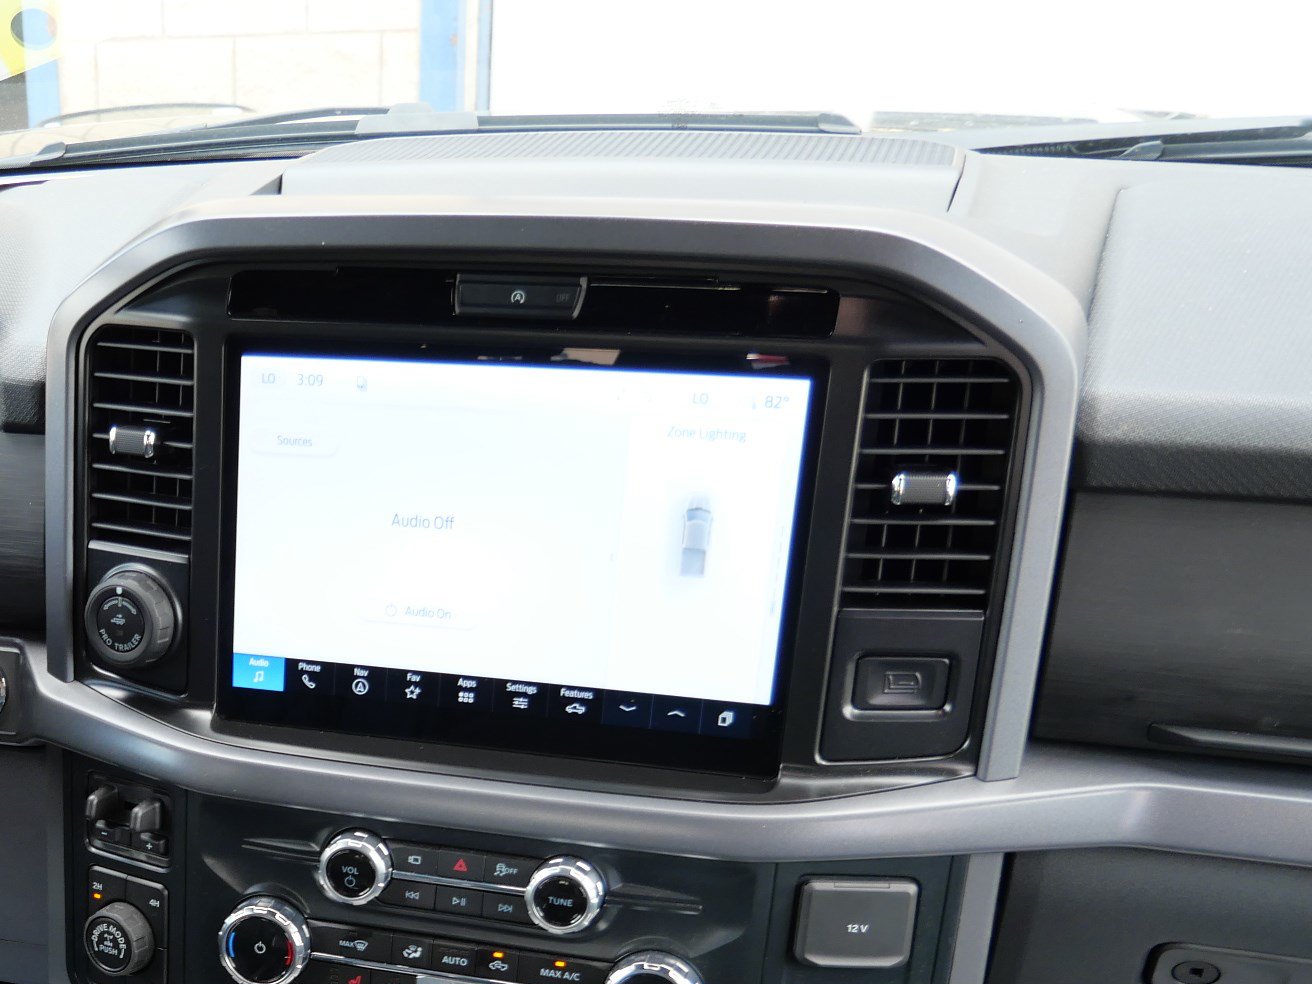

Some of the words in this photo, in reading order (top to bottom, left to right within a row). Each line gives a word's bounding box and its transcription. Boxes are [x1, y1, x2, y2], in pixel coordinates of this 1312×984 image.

[260, 372, 277, 385] LO
[296, 372, 324, 387] 3:09
[691, 391, 710, 406] LO
[666, 425, 696, 440] Zone
[699, 427, 748, 444] Lighting
[276, 434, 314, 448] Sources
[390, 511, 431, 530] Audio
[433, 513, 456, 530] Off
[404, 605, 435, 619] Audio
[437, 606, 453, 620] On
[99, 628, 113, 645] PRO
[114, 633, 142, 651] TRAILER
[248, 656, 269, 668] Audio
[298, 662, 321, 673] Phone
[353, 667, 369, 677] Nav
[406, 672, 421, 683] Fav
[457, 678, 476, 689] Apps
[505, 682, 537, 695] Settings
[560, 687, 593, 700] Features
[341, 866, 359, 875] VOL
[505, 867, 518, 876] OFF
[92, 882, 103, 891] 2H
[149, 899, 160, 908] 4H
[547, 896, 573, 908] TUNE
[91, 923, 108, 942] DRIVE
[108, 925, 127, 949] MODE
[99, 944, 118, 956] PUSH
[339, 940, 354, 948] MAX
[442, 955, 468, 967] AUTO
[540, 968, 562, 978] MAX
[563, 970, 581, 982] A/C
